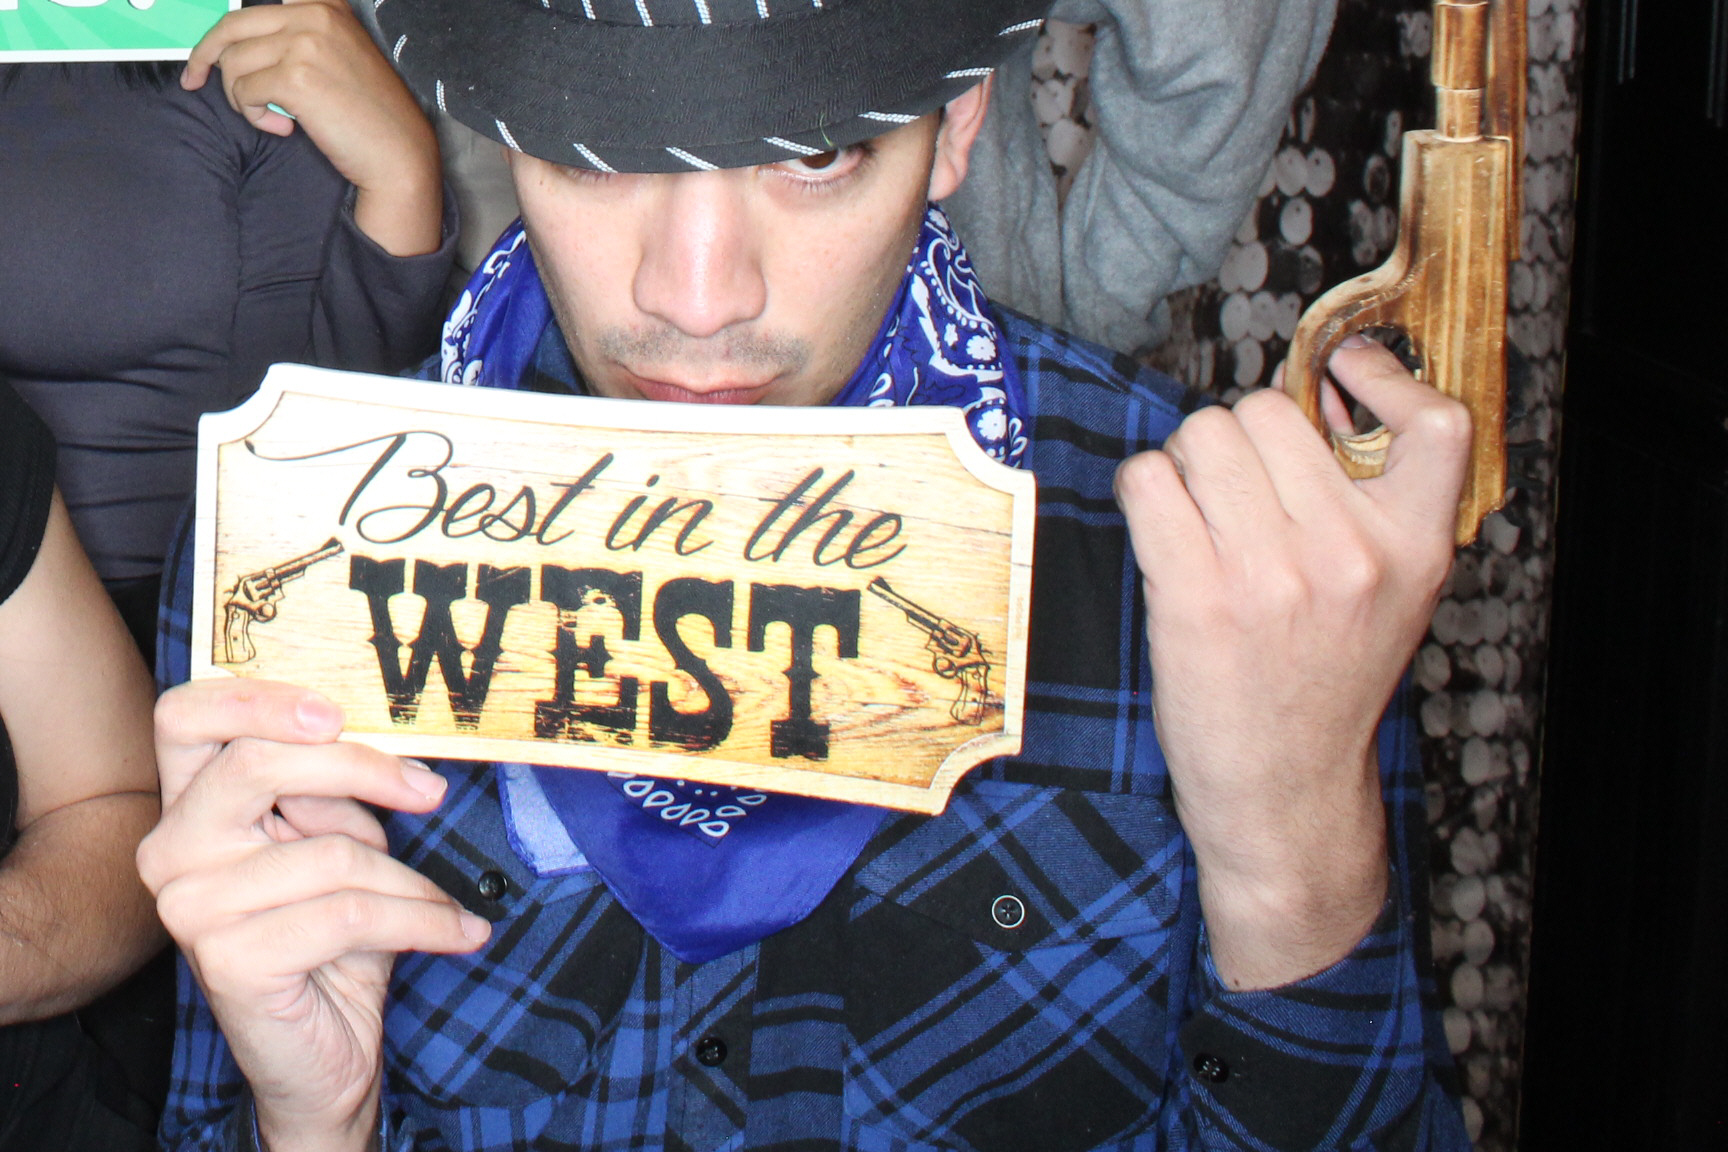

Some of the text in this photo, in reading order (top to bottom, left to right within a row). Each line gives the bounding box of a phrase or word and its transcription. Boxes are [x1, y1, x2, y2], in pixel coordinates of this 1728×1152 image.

[244, 430, 908, 569] Best in the
[349, 555, 862, 760] WEST
